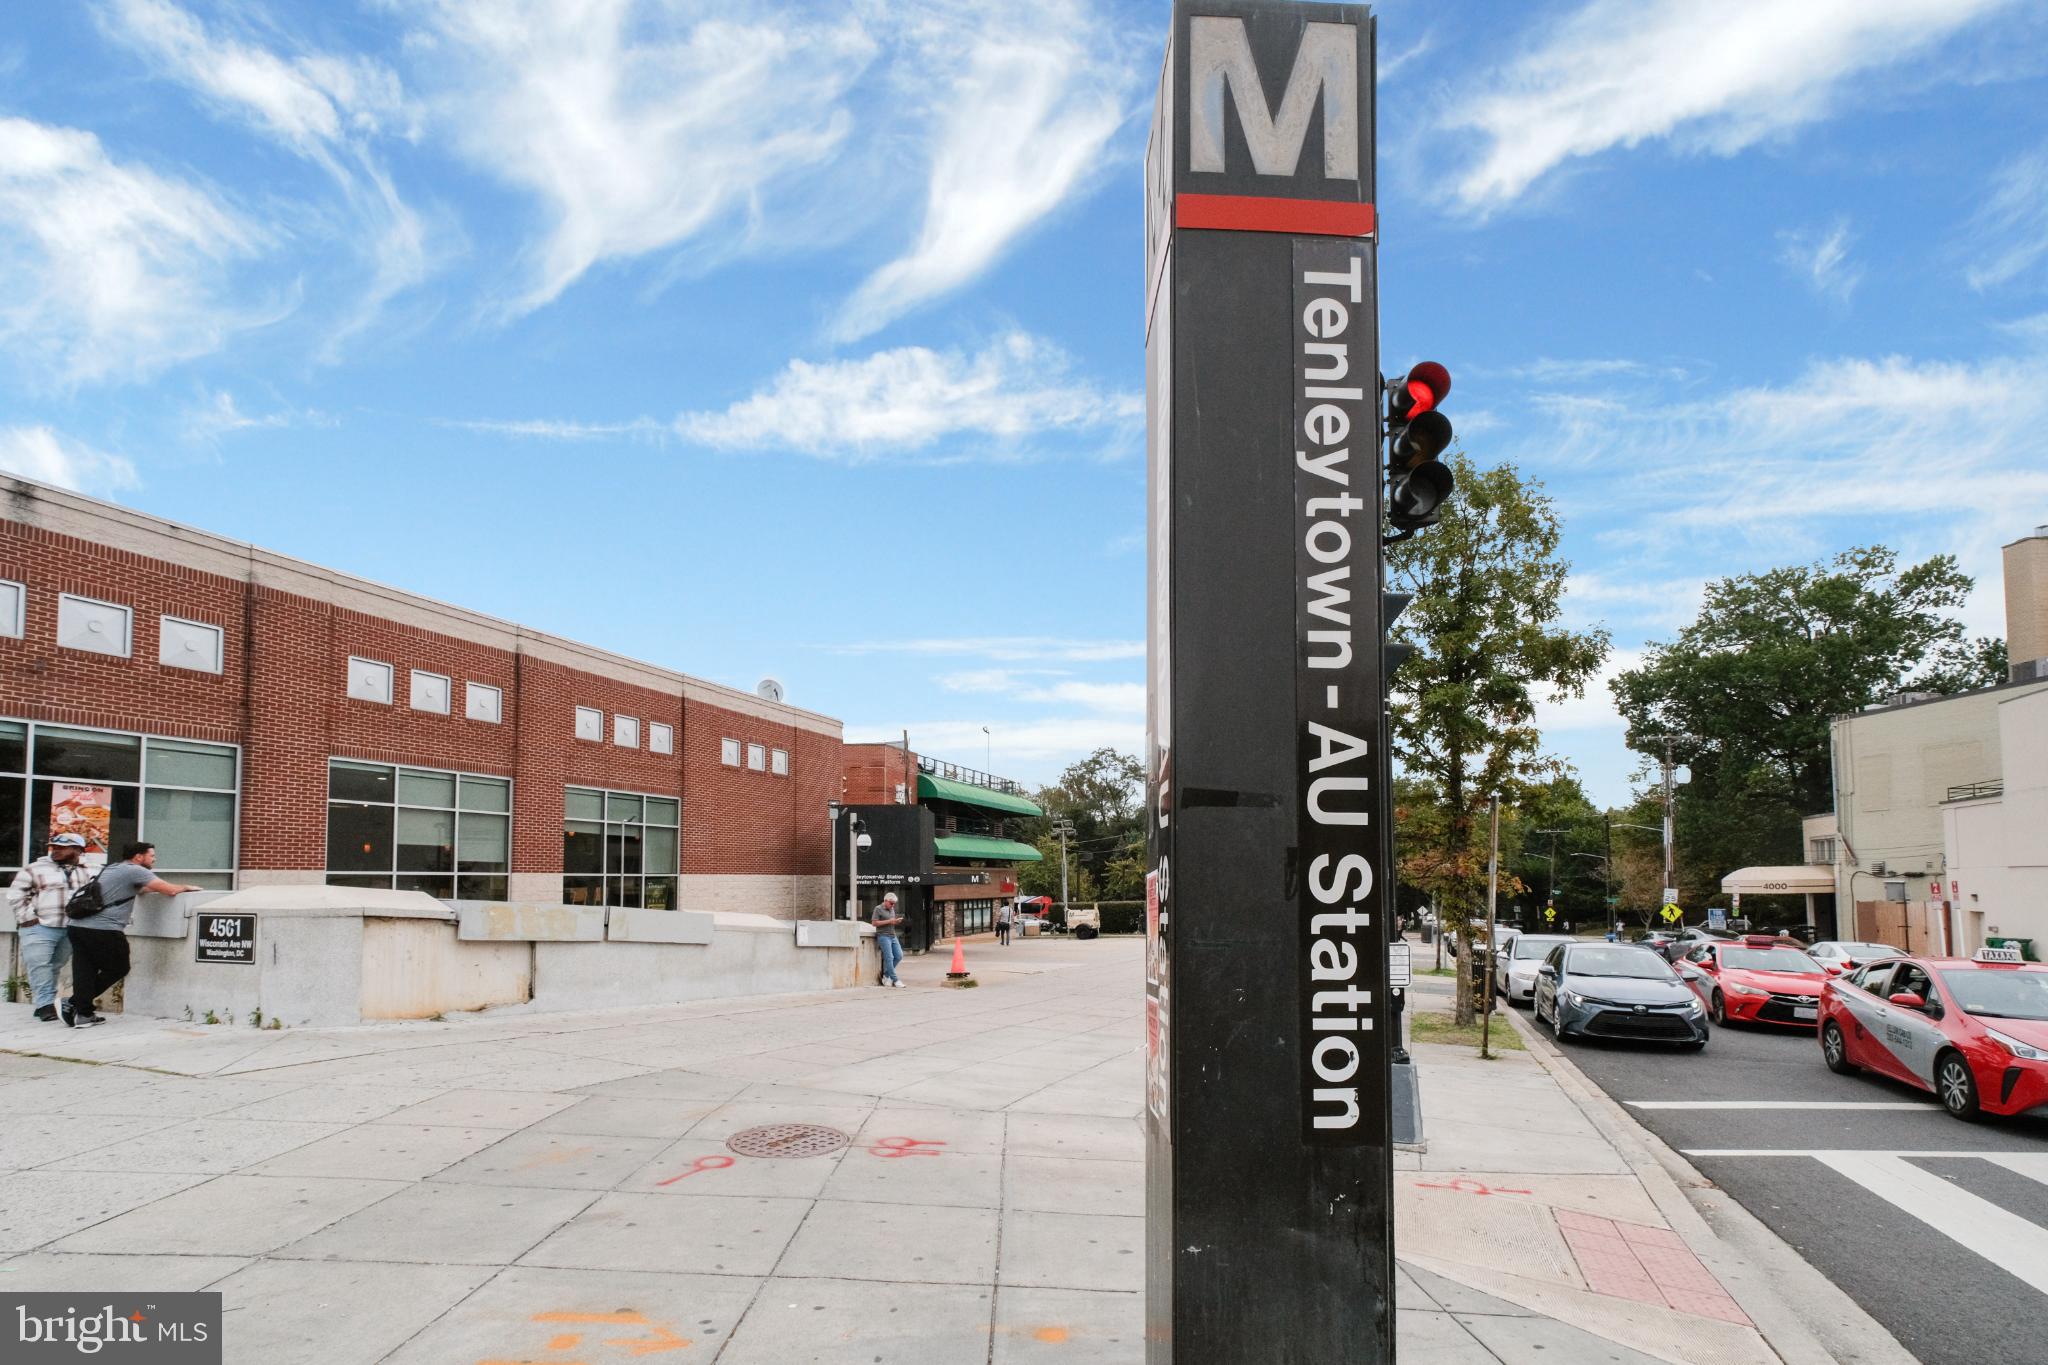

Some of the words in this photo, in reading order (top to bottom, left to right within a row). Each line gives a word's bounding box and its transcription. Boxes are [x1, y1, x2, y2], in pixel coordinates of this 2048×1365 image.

[1190, 16, 1358, 181] M
[1296, 256, 1369, 826] Tenleytown-AU
[200, 938, 229, 948] Wisconsin
[229, 939, 241, 949] Ave
[241, 939, 253, 949] NW
[236, 949, 245, 957] DC
[1308, 853, 1374, 1129] Station
